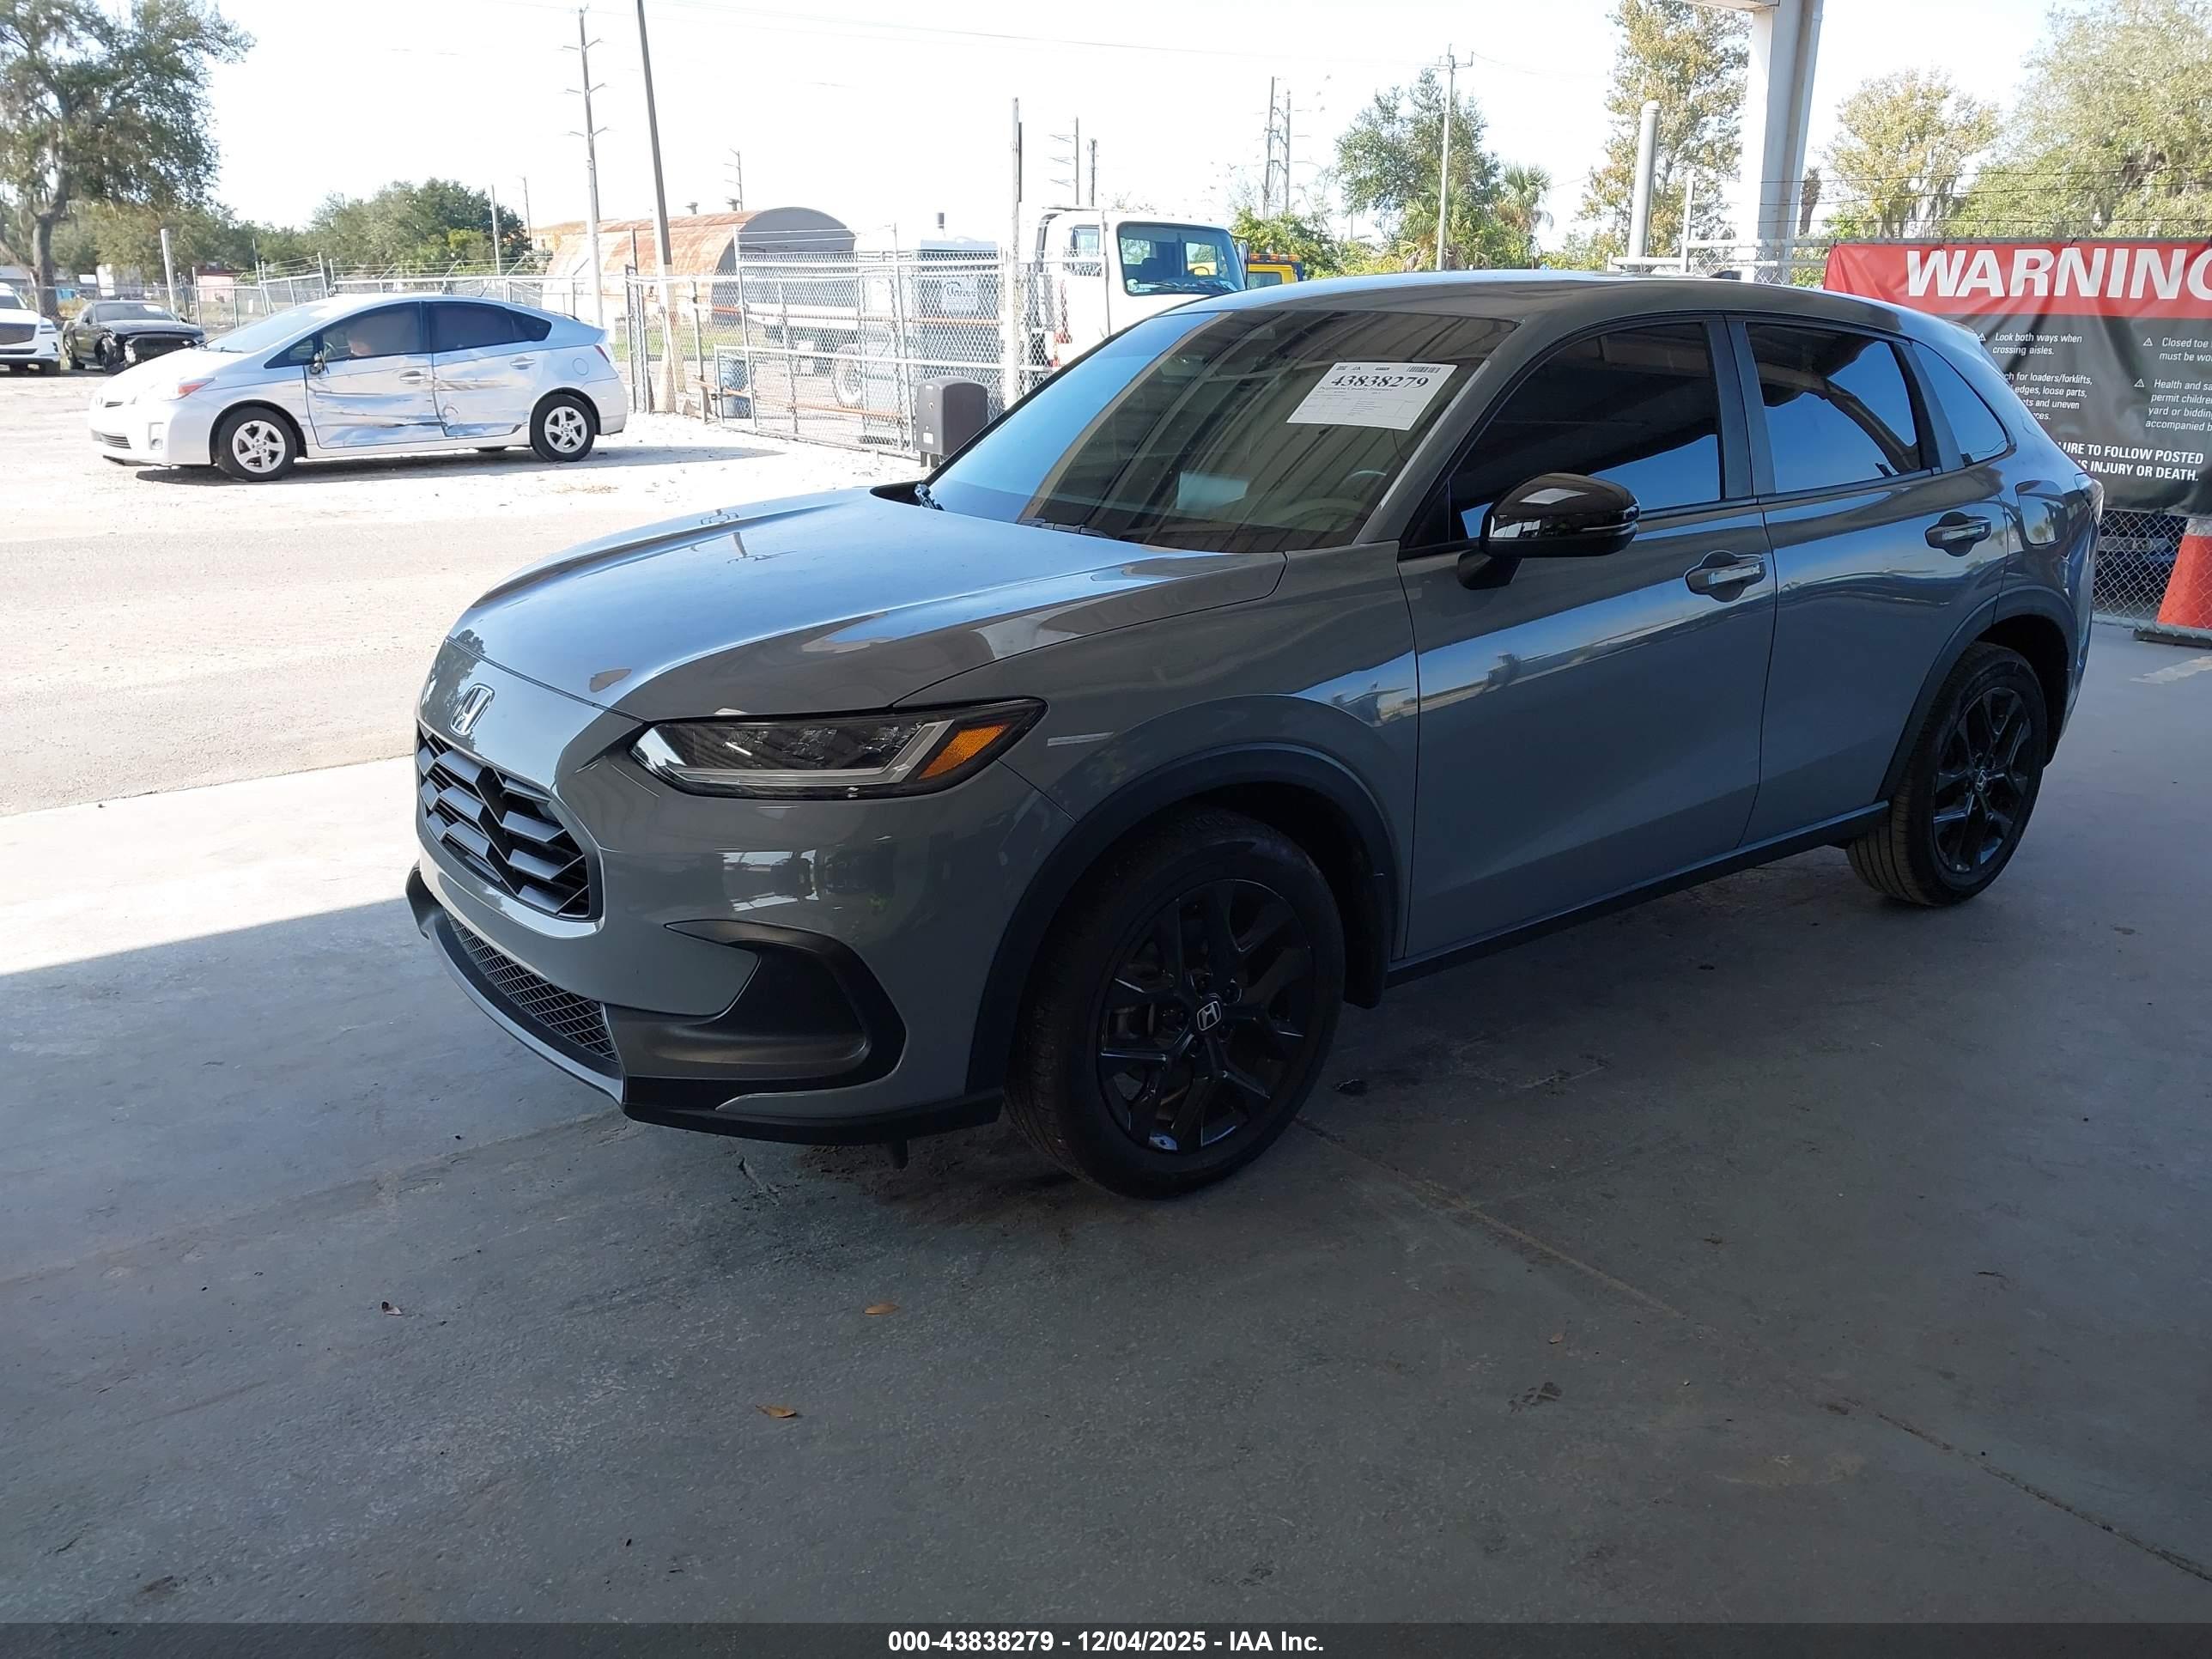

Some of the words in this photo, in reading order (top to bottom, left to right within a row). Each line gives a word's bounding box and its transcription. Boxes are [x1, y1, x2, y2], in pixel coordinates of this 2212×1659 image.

[1995, 332, 2013, 342] Look
[2014, 332, 2034, 342] both
[2036, 334, 2058, 343] ways
[2061, 333, 2082, 343] when
[2162, 337, 2192, 347] Closed
[2194, 339, 2209, 348] toe
[1992, 345, 2027, 356] crossing
[2029, 346, 2055, 355] aisles.
[2159, 352, 2181, 361] must
[2184, 351, 2195, 361] be
[1331, 374, 1429, 388] 43838279
[2016, 372, 2028, 380] for
[2030, 372, 2093, 386] loaders/forklifts,
[2154, 379, 2182, 389] Health
[2185, 380, 2202, 390] and
[2014, 385, 2041, 396] edges,
[2042, 386, 2064, 395] loose
[2066, 388, 2087, 398] parts,
[2035, 398, 2051, 407] and
[2051, 401, 2080, 410] uneven
[2150, 393, 2179, 403] permit
[2181, 393, 2212, 404] childre
[2148, 406, 2169, 416] yard
[2183, 408, 2212, 421] biddin
[2145, 420, 2205, 432] accompanied
[2087, 444, 2101, 456] TO
[2104, 446, 2153, 460] FOLLOW
[2154, 449, 2204, 465] POSTED
[2090, 460, 2134, 476] INJURY
[2136, 465, 2153, 477] OR
[2155, 466, 2199, 482] DEATH.
